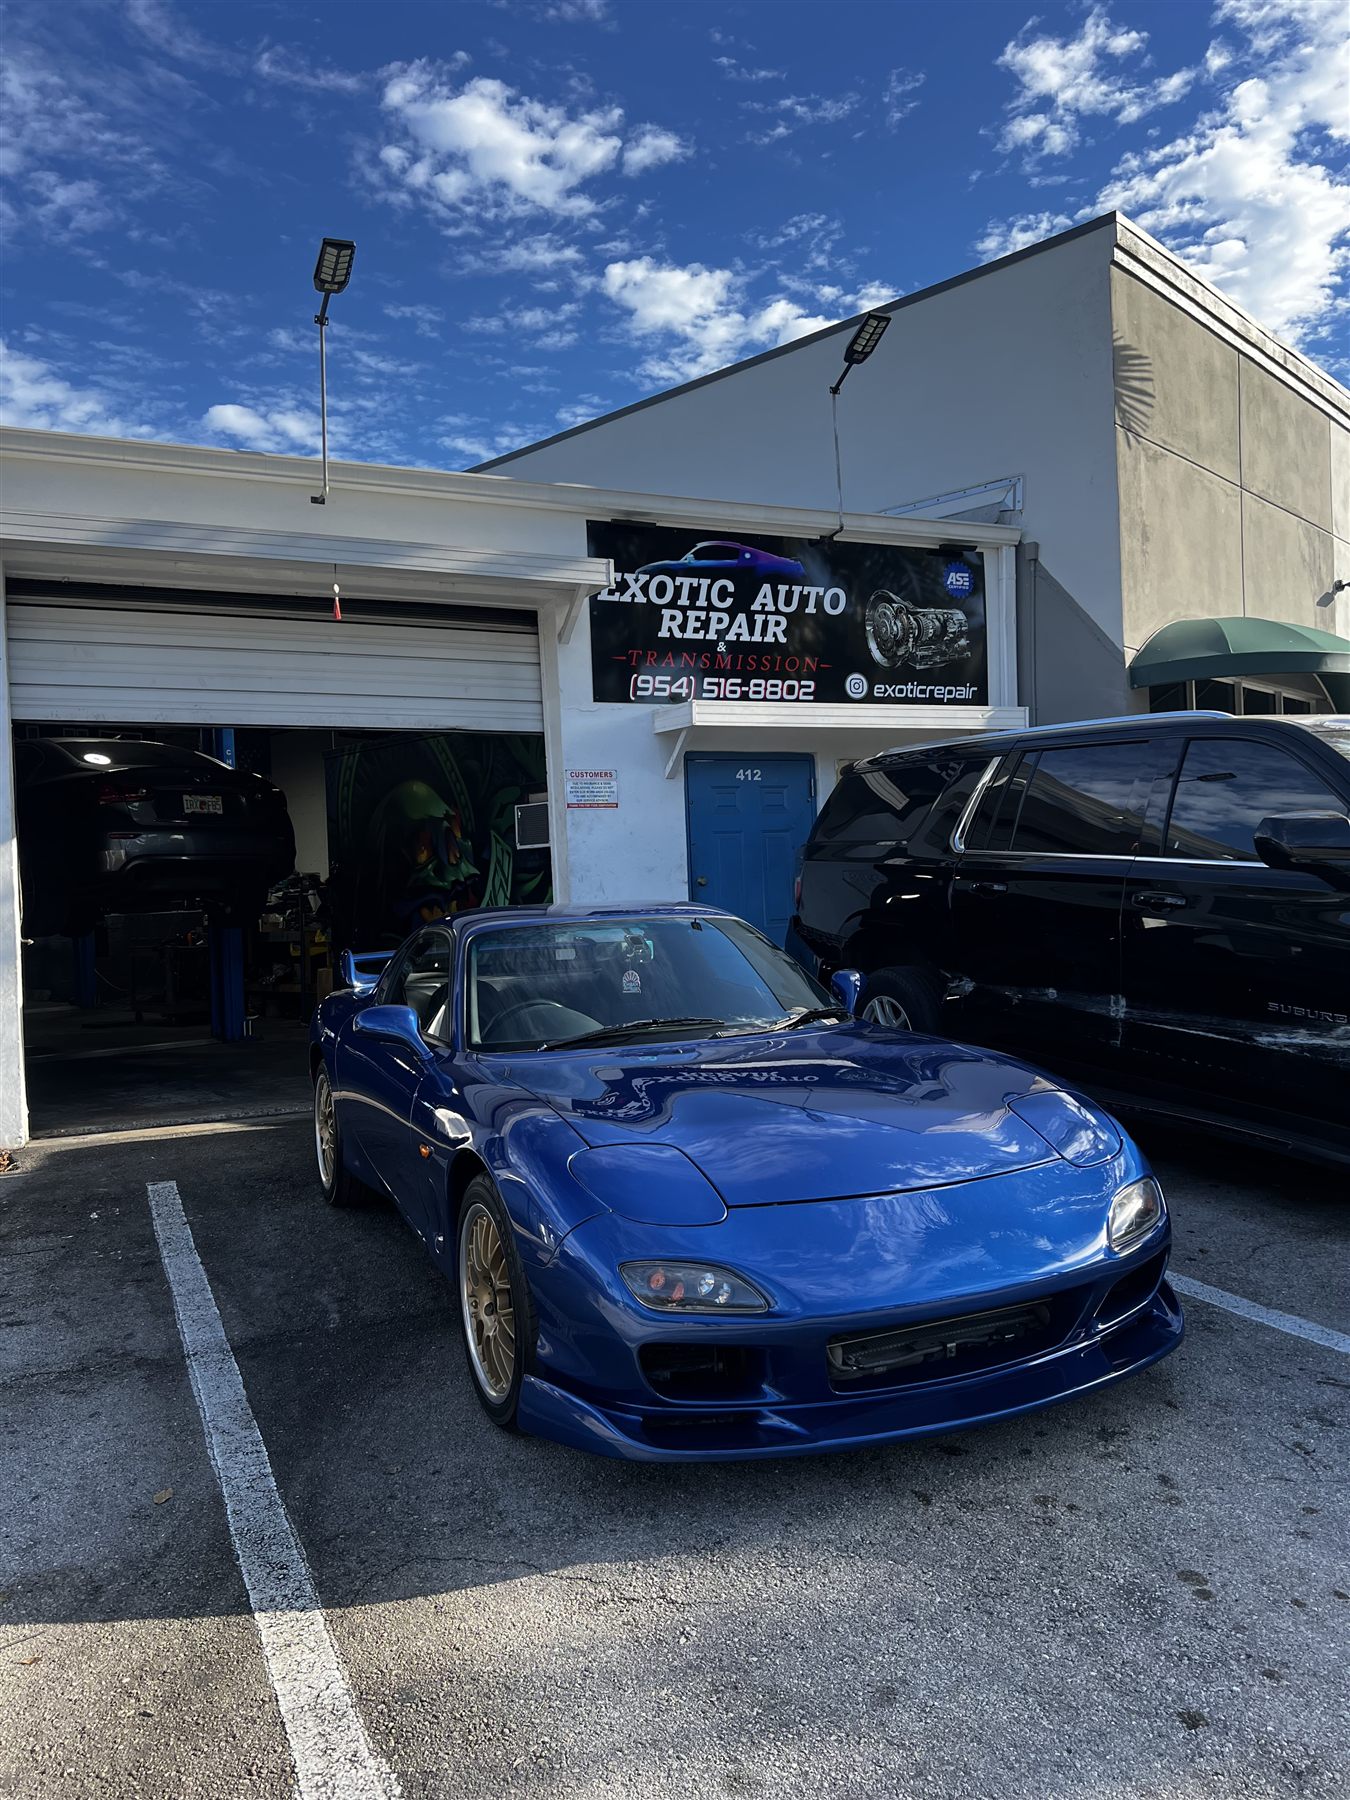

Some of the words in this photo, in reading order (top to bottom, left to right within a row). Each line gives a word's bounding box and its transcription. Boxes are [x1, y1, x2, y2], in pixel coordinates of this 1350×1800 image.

[946, 572, 970, 586] ASE
[597, 572, 735, 608] EXOTIC
[750, 583, 847, 616] AUTO
[657, 608, 788, 643] REPAIR
[716, 641, 727, 652] &
[627, 649, 819, 672] TRANSMISSION
[629, 673, 696, 701] (954)
[702, 677, 815, 700] 516-8802
[873, 681, 978, 703] exoticrepair
[735, 769, 762, 781] 412
[1267, 1002, 1348, 1023] SUBURB
